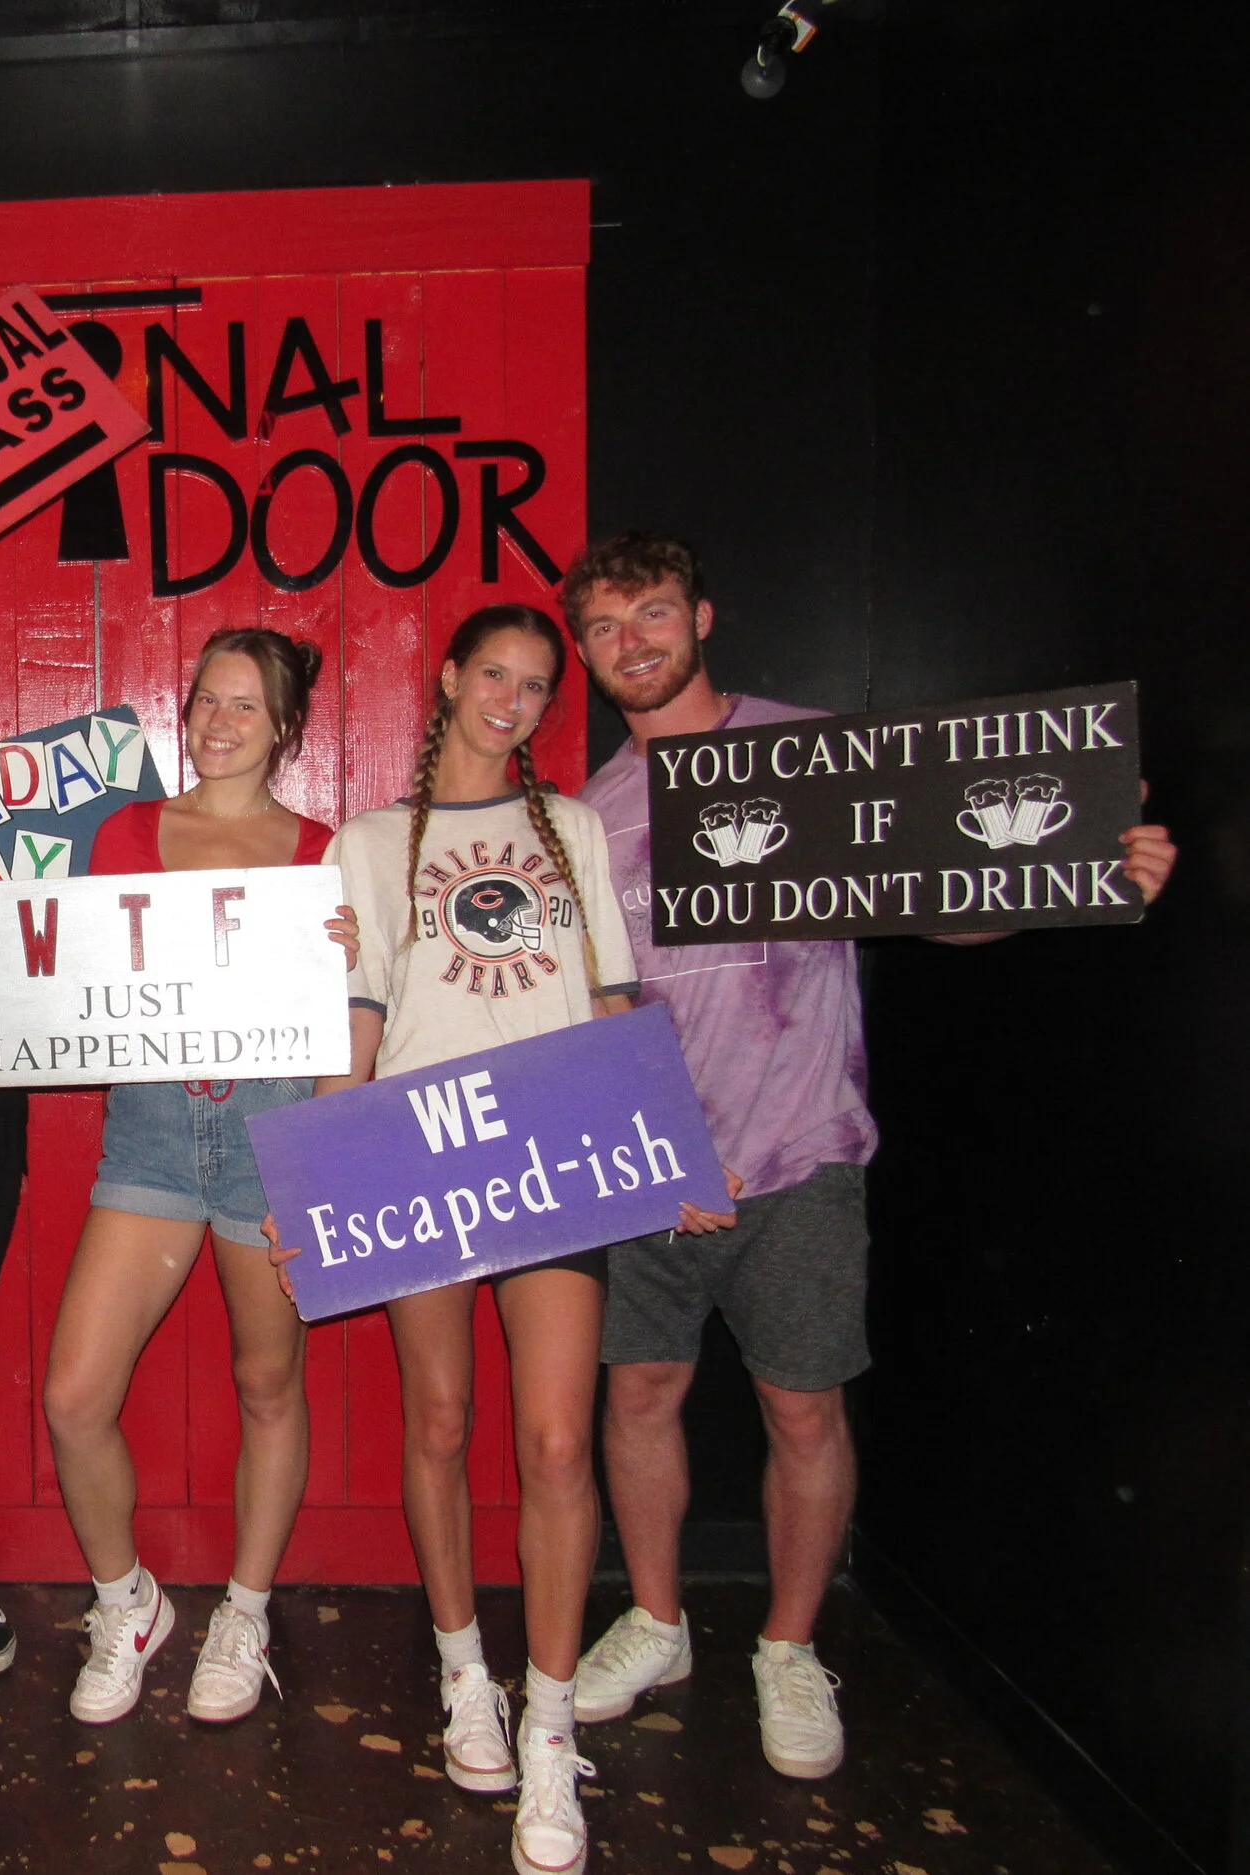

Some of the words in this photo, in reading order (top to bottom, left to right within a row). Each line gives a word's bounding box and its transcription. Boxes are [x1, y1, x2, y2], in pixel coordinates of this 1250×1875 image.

[147, 440, 563, 598] DOOR
[657, 740, 756, 790] YOU
[770, 723, 923, 779] CAN'T
[937, 702, 1124, 763] THINK
[850, 799, 896, 845] IF
[549, 896, 572, 929] 20
[622, 884, 651, 911] CU
[657, 882, 756, 929] YOU
[770, 871, 923, 923] DON'T
[938, 859, 1130, 914] DRINK
[79, 982, 193, 1021] JUST
[439, 951, 558, 998] BEARS
[406, 1070, 508, 1154] WE
[306, 1110, 687, 1269] Escaped-ish
